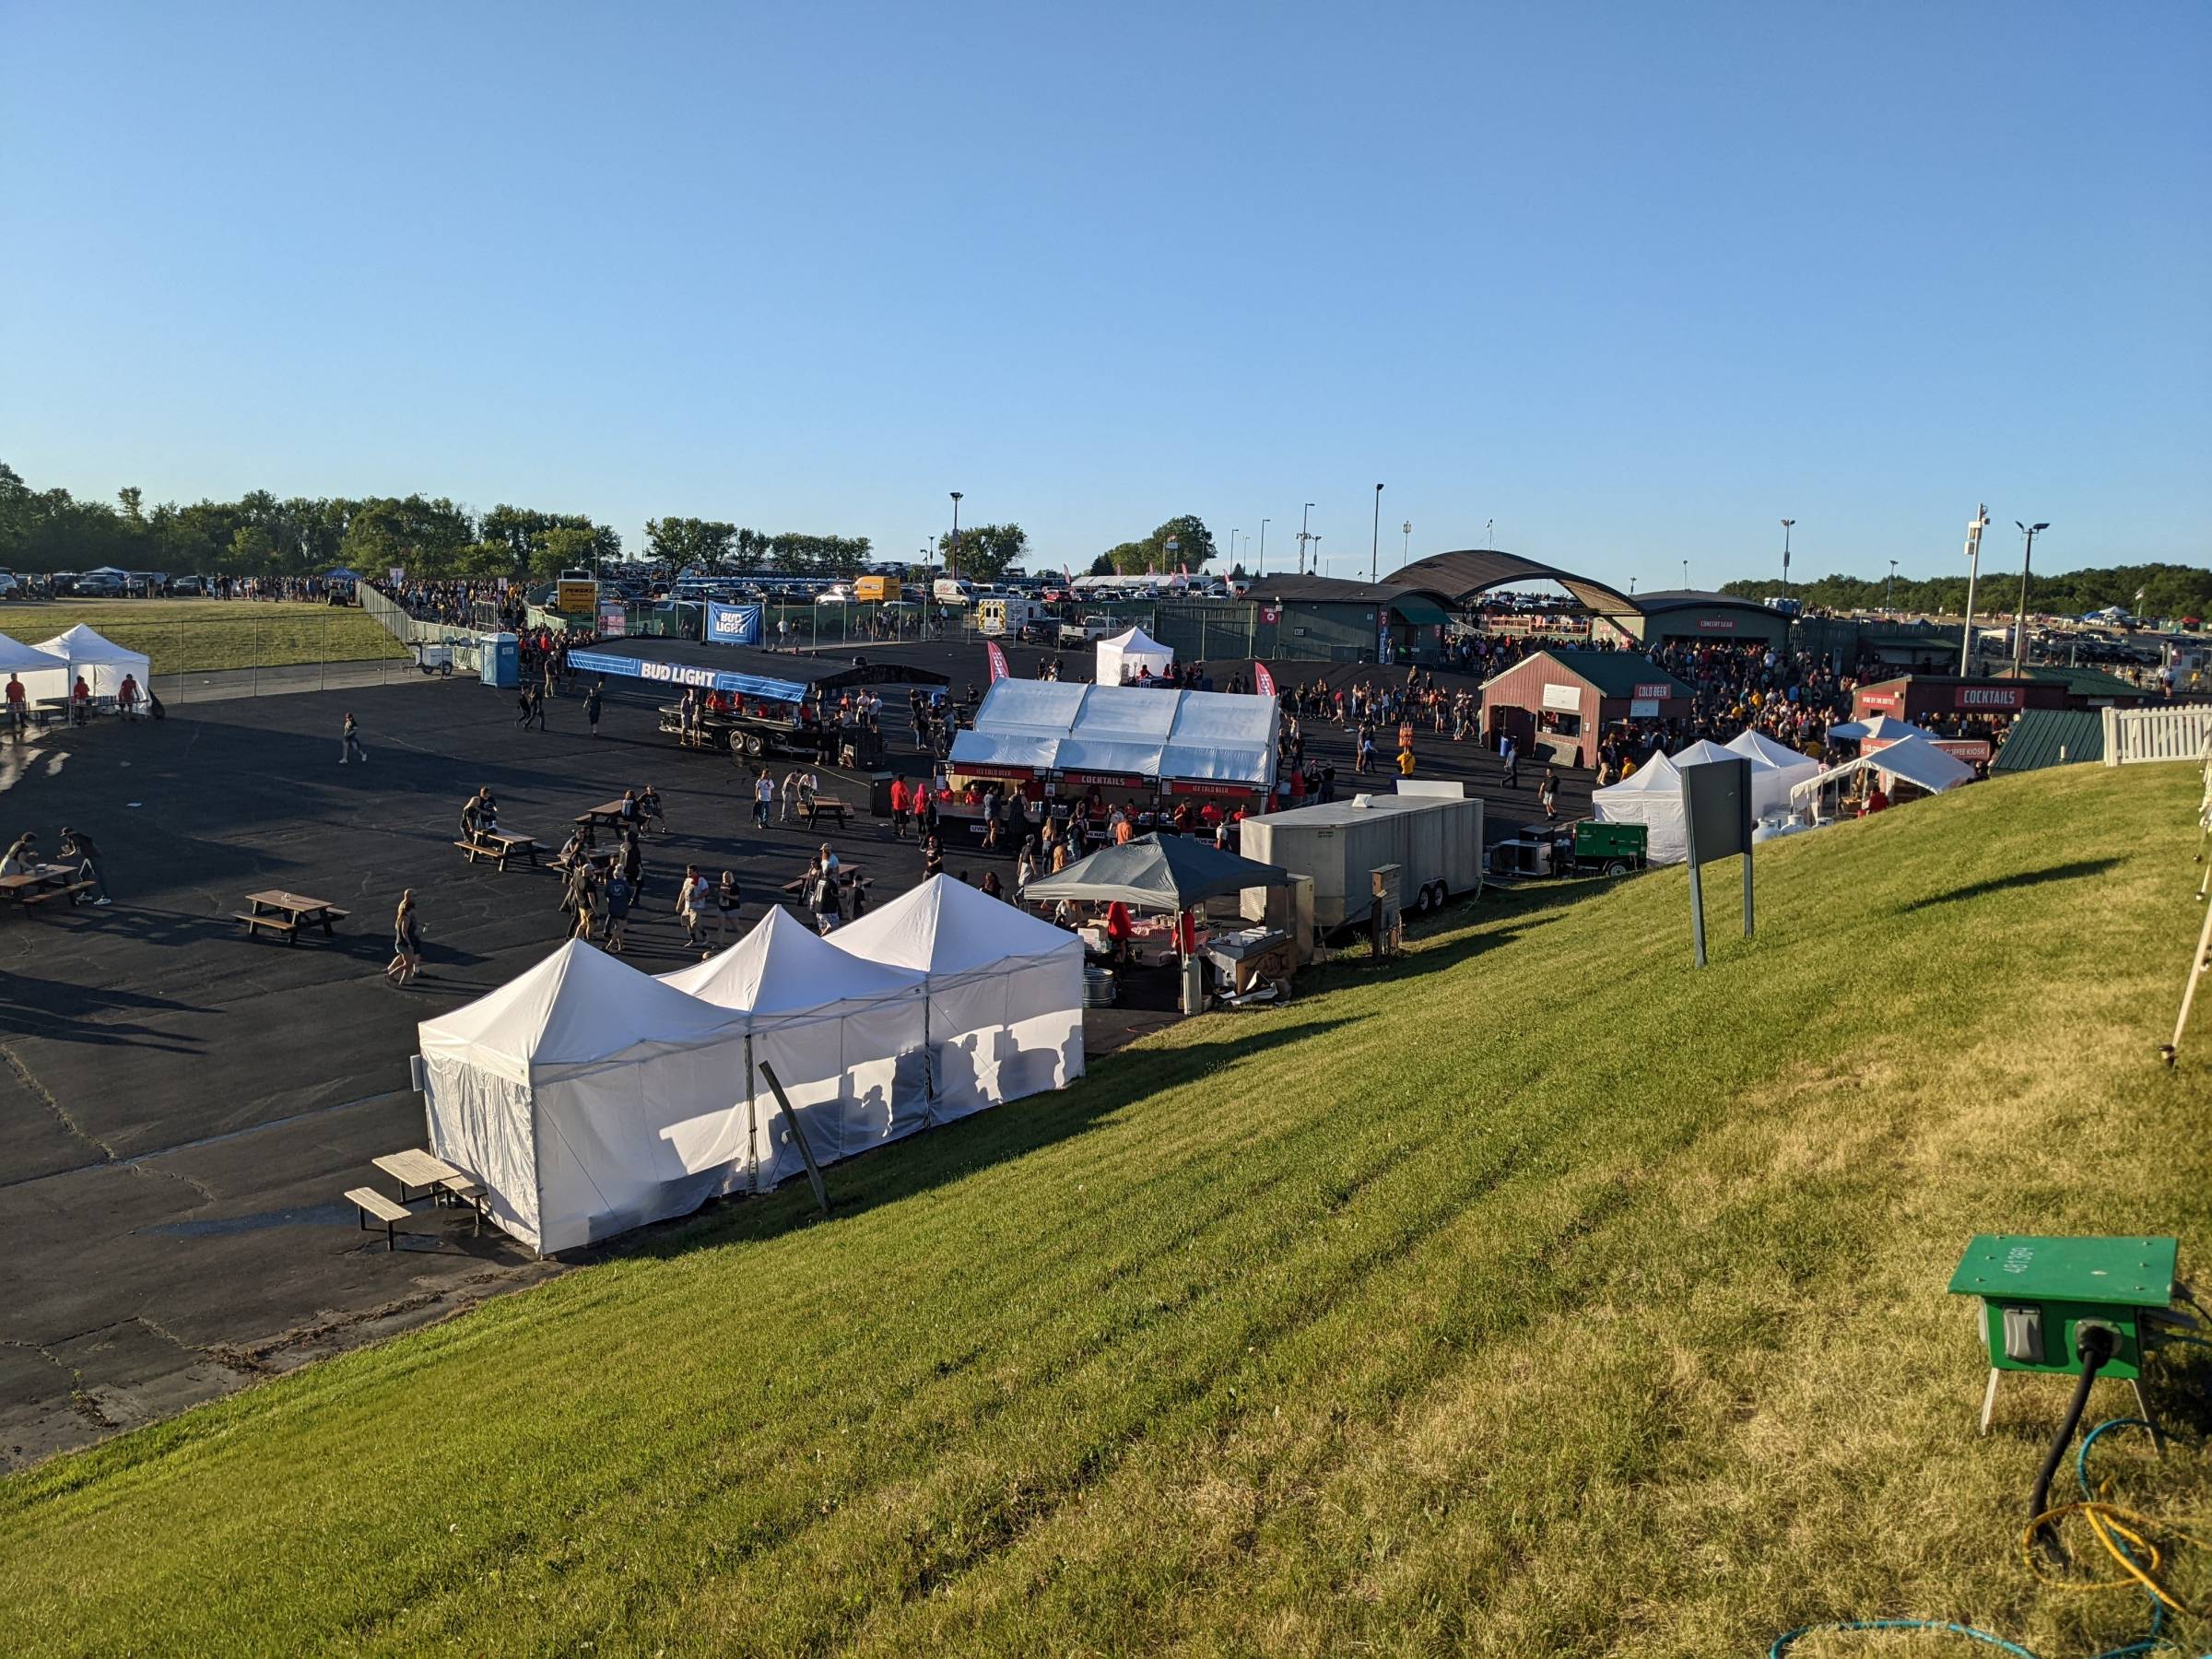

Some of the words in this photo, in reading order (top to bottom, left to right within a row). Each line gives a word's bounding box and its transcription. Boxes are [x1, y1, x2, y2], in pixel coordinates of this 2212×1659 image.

[721, 612, 742, 623] BUD
[715, 621, 745, 634] LIGHT
[641, 663, 672, 681] BUD
[672, 667, 715, 687] LIGHT
[1639, 686, 1653, 697] COLD
[1653, 686, 1667, 697] BEER
[1963, 689, 2016, 705] COCKTAILS
[1966, 747, 1985, 756] KIOSK
[1081, 774, 1125, 786] COCKTAILS
